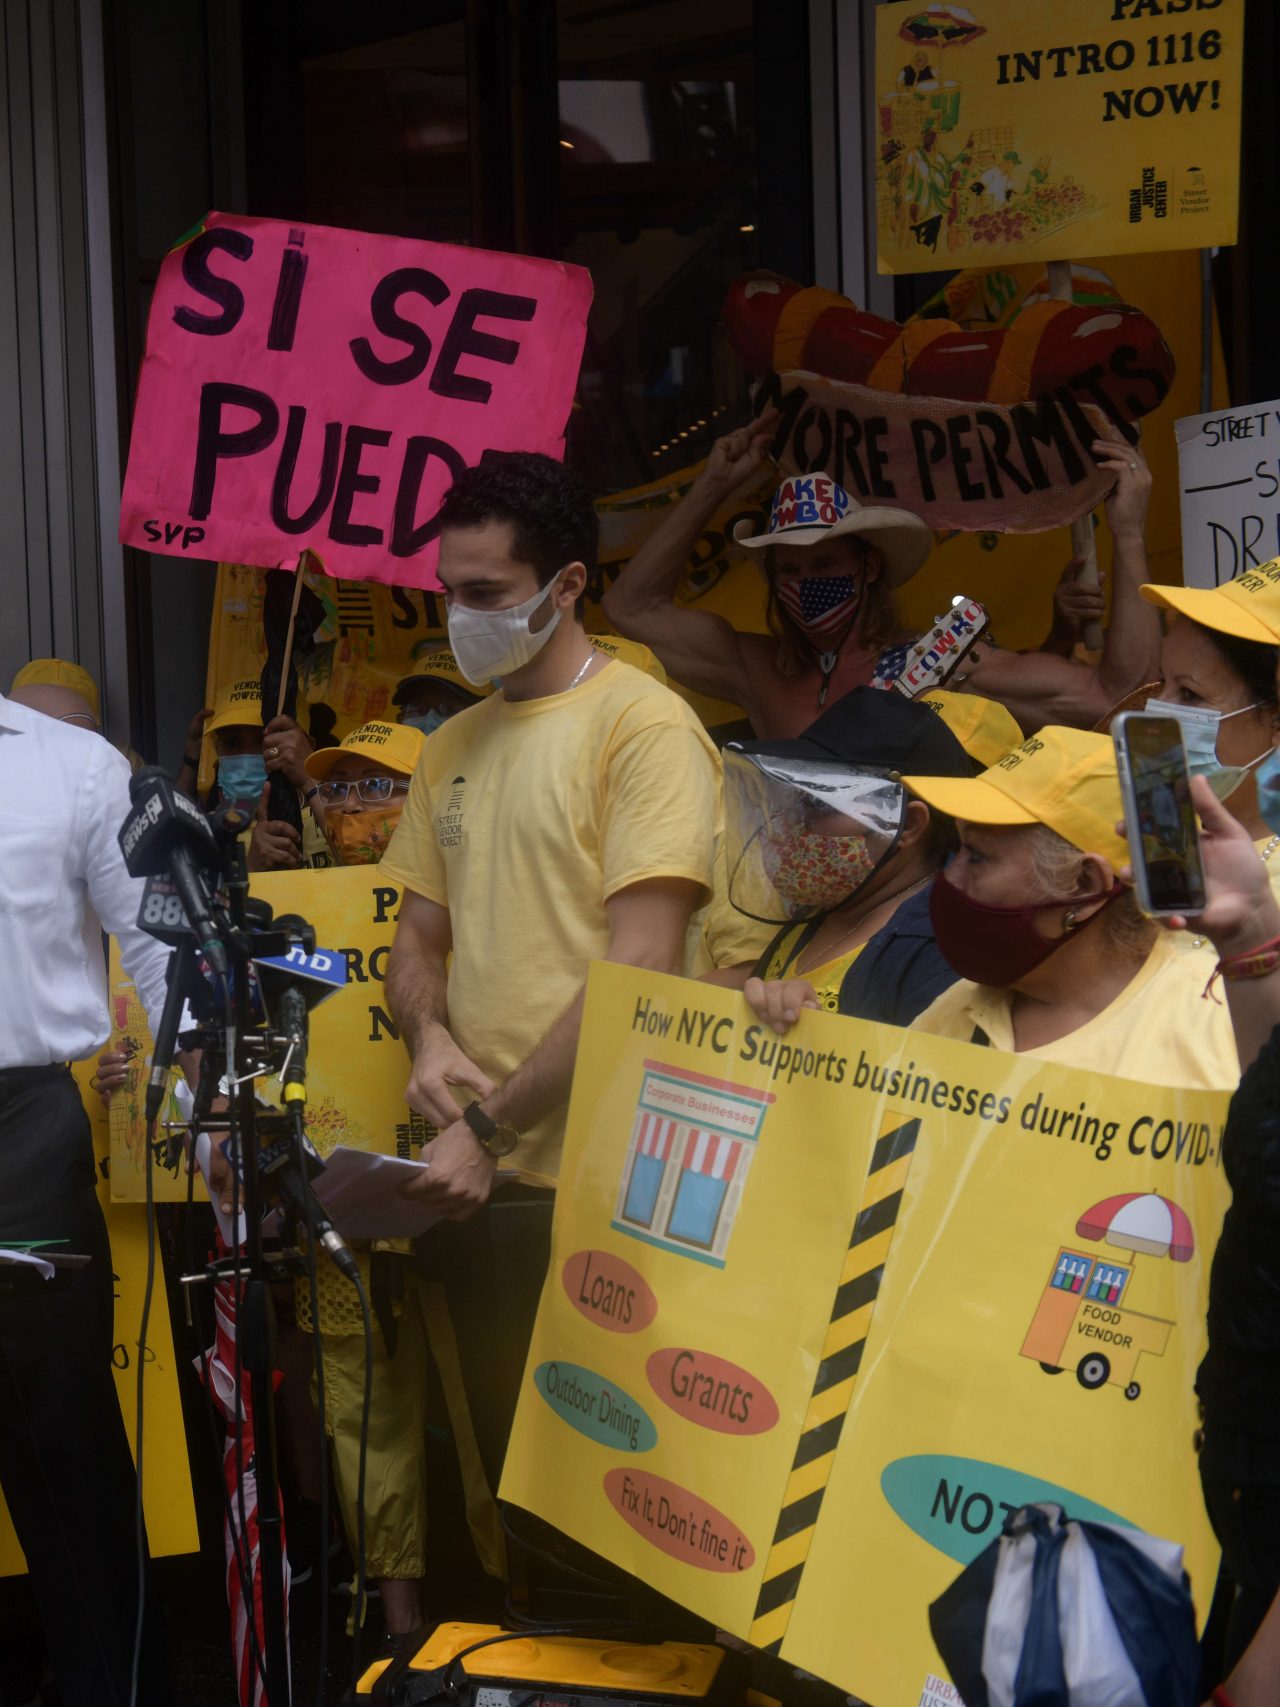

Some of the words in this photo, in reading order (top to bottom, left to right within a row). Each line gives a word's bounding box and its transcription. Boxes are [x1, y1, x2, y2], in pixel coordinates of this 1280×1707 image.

[997, 39, 1135, 84] INTRO
[1147, 29, 1221, 67] 1116
[1102, 80, 1221, 122] NOW!
[349, 267, 537, 404] SE
[911, 345, 1171, 501] PERMITS
[1202, 413, 1270, 446] STREET
[188, 382, 528, 558] PUED
[428, 654, 457, 664] VENDO
[439, 814, 464, 827] STREET
[632, 996, 673, 1038] How
[676, 1007, 734, 1054] NYC
[739, 1024, 848, 1084] Supports
[853, 1051, 1012, 1125] businesses
[1020, 1093, 1120, 1161] during
[646, 1083, 686, 1106] Corporate
[687, 1096, 756, 1126] Businesses
[579, 1252, 635, 1325] Loans
[1082, 1304, 1122, 1325] FOOD
[1077, 1321, 1133, 1349] VENDOR
[546, 1362, 597, 1417] Outdoor
[598, 1390, 641, 1451] Dining
[670, 1351, 753, 1424] Grants
[621, 1476, 639, 1517] Fix
[657, 1496, 697, 1547] Don't
[699, 1518, 729, 1561] fine
[731, 1537, 747, 1572] it
